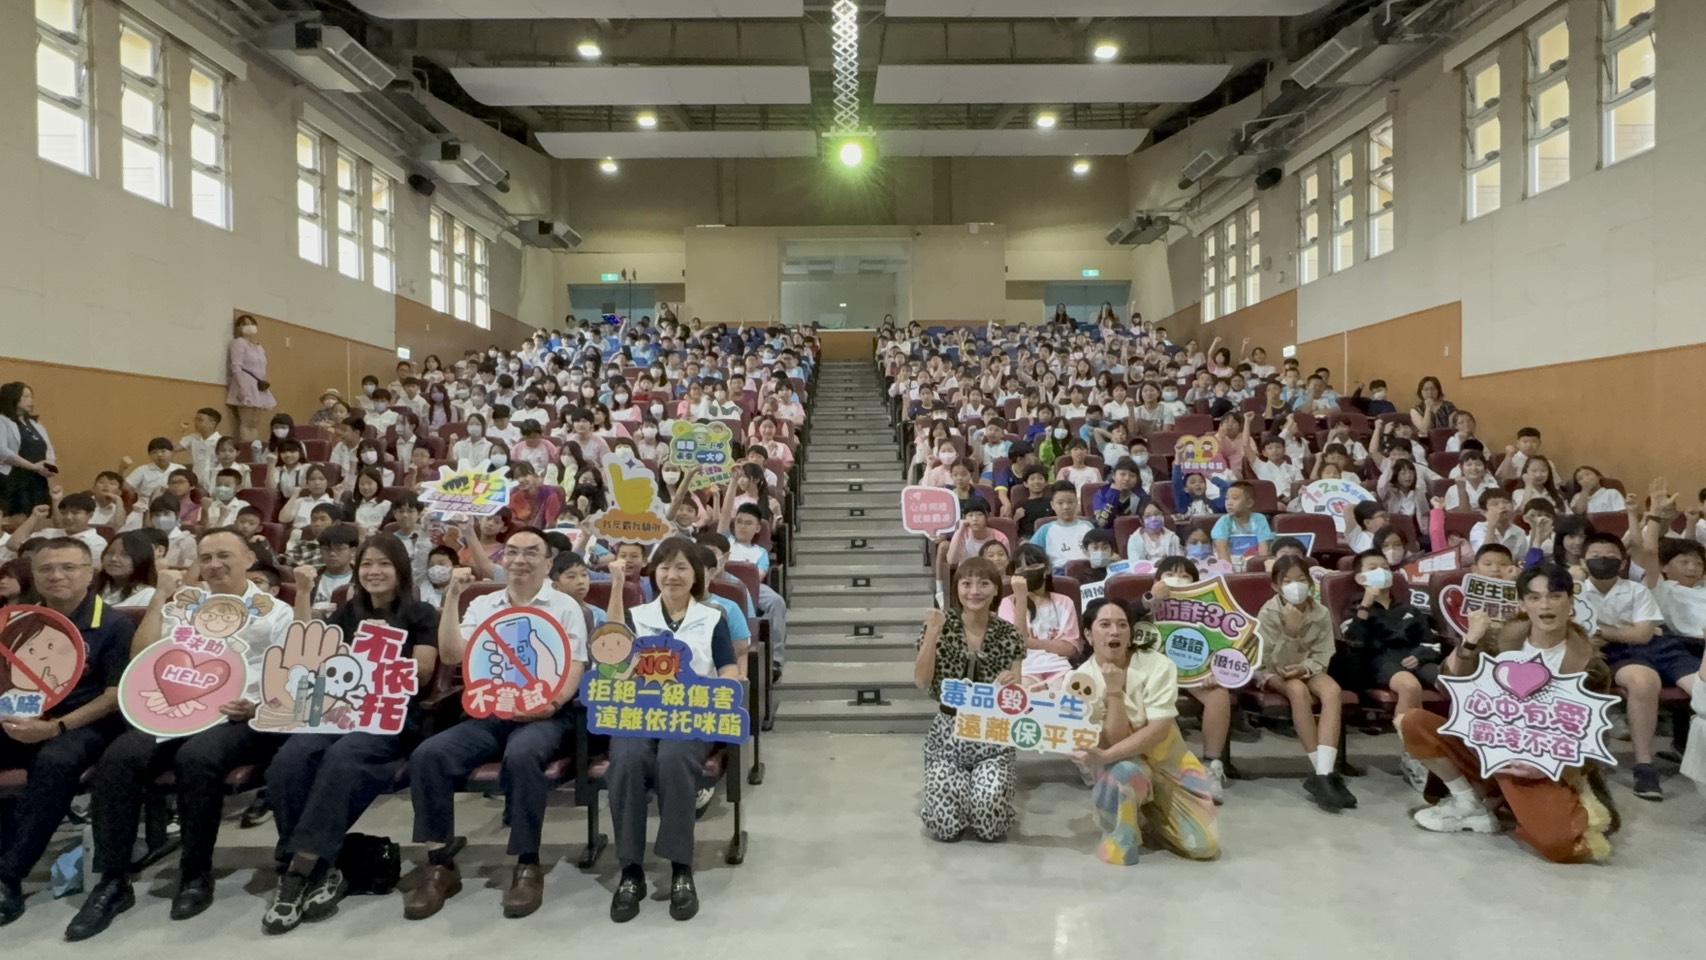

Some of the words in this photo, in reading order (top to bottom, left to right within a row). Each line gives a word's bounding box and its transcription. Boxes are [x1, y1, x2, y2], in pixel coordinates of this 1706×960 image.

[1467, 578, 1518, 601] 陌生電
[1171, 634, 1205, 655] 查證
[164, 666, 217, 687] HELP
[353, 622, 415, 731] 不依托
[636, 653, 680, 675] NO!
[467, 682, 547, 712] 不嘗試
[587, 678, 734, 710] 拒絕一級傷害
[943, 681, 1084, 719] 毒品毀一生
[595, 705, 741, 736] 遠離依托咪酯
[1467, 691, 1588, 735] 心中有愛
[957, 713, 1098, 750] 遠離保平安
[1472, 721, 1577, 759] 霸凌不在
